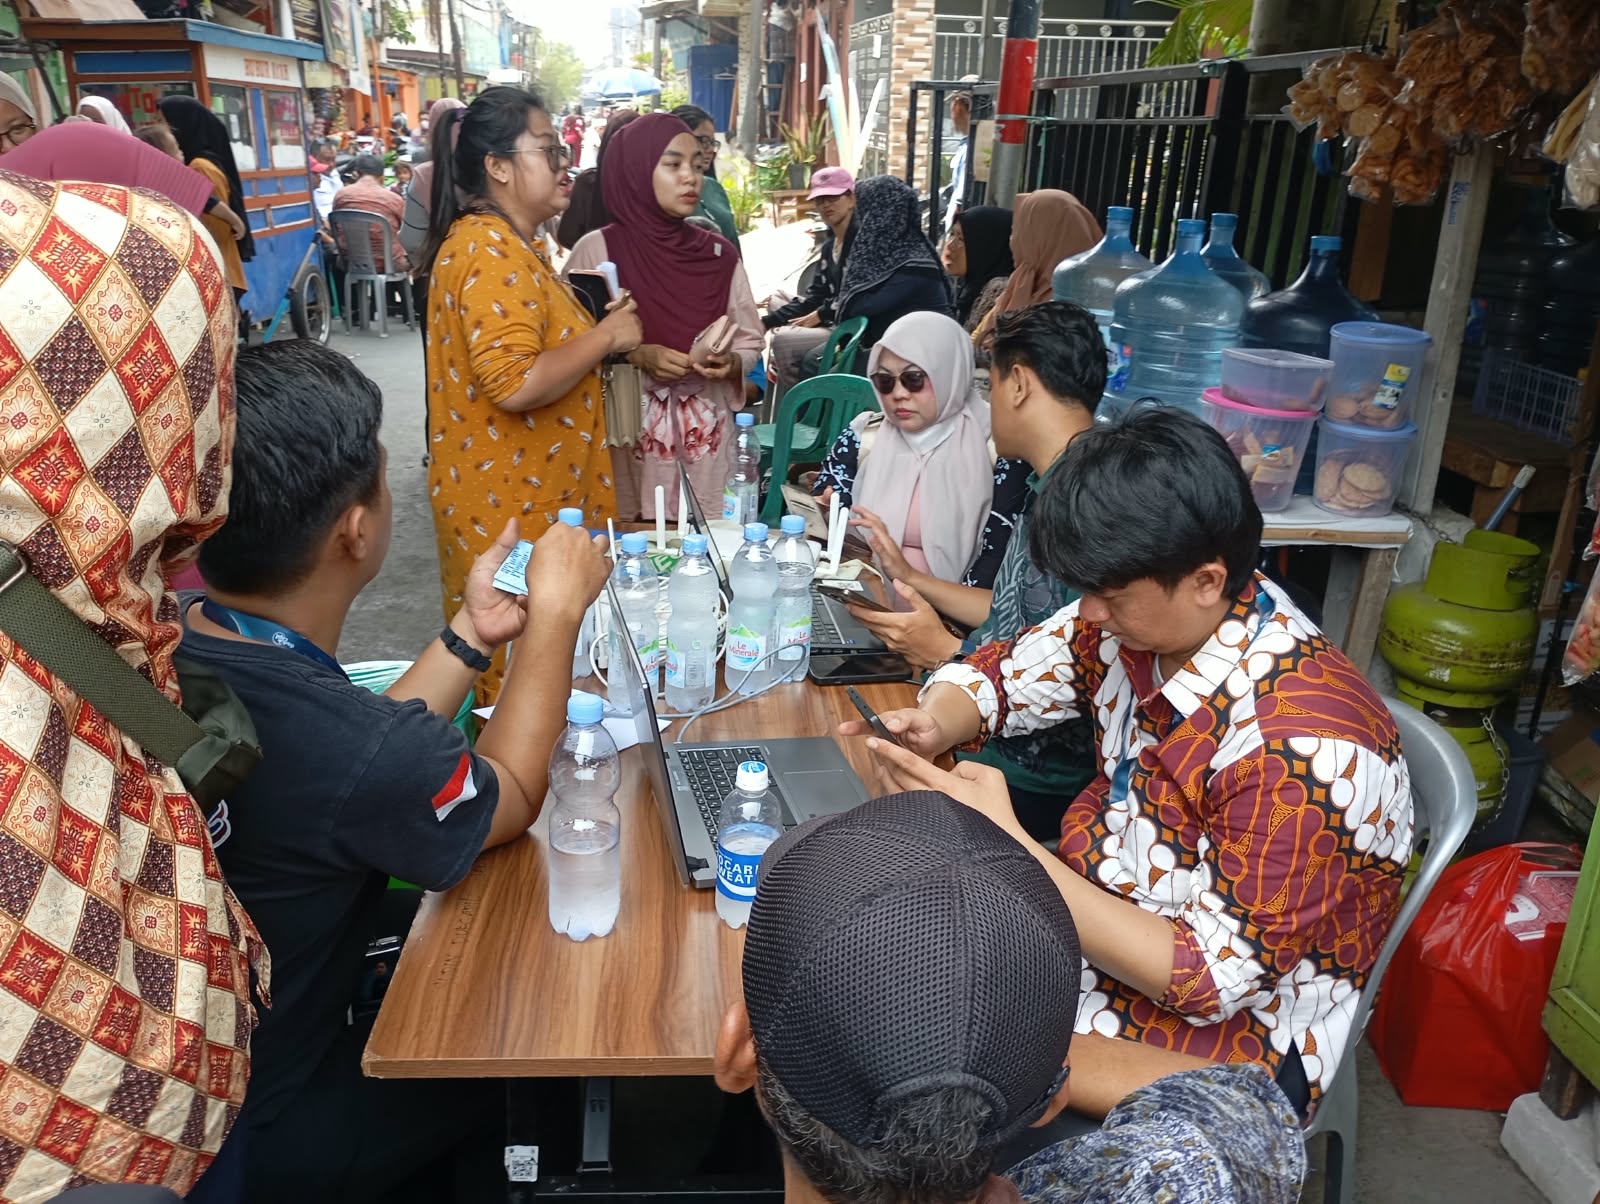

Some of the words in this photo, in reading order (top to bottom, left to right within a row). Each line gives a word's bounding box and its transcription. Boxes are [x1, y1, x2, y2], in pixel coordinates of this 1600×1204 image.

[728, 645, 759, 657] Minerale
[737, 641, 747, 650] Le
[718, 855, 759, 875] OCARI
[718, 866, 754, 885] WEAT
